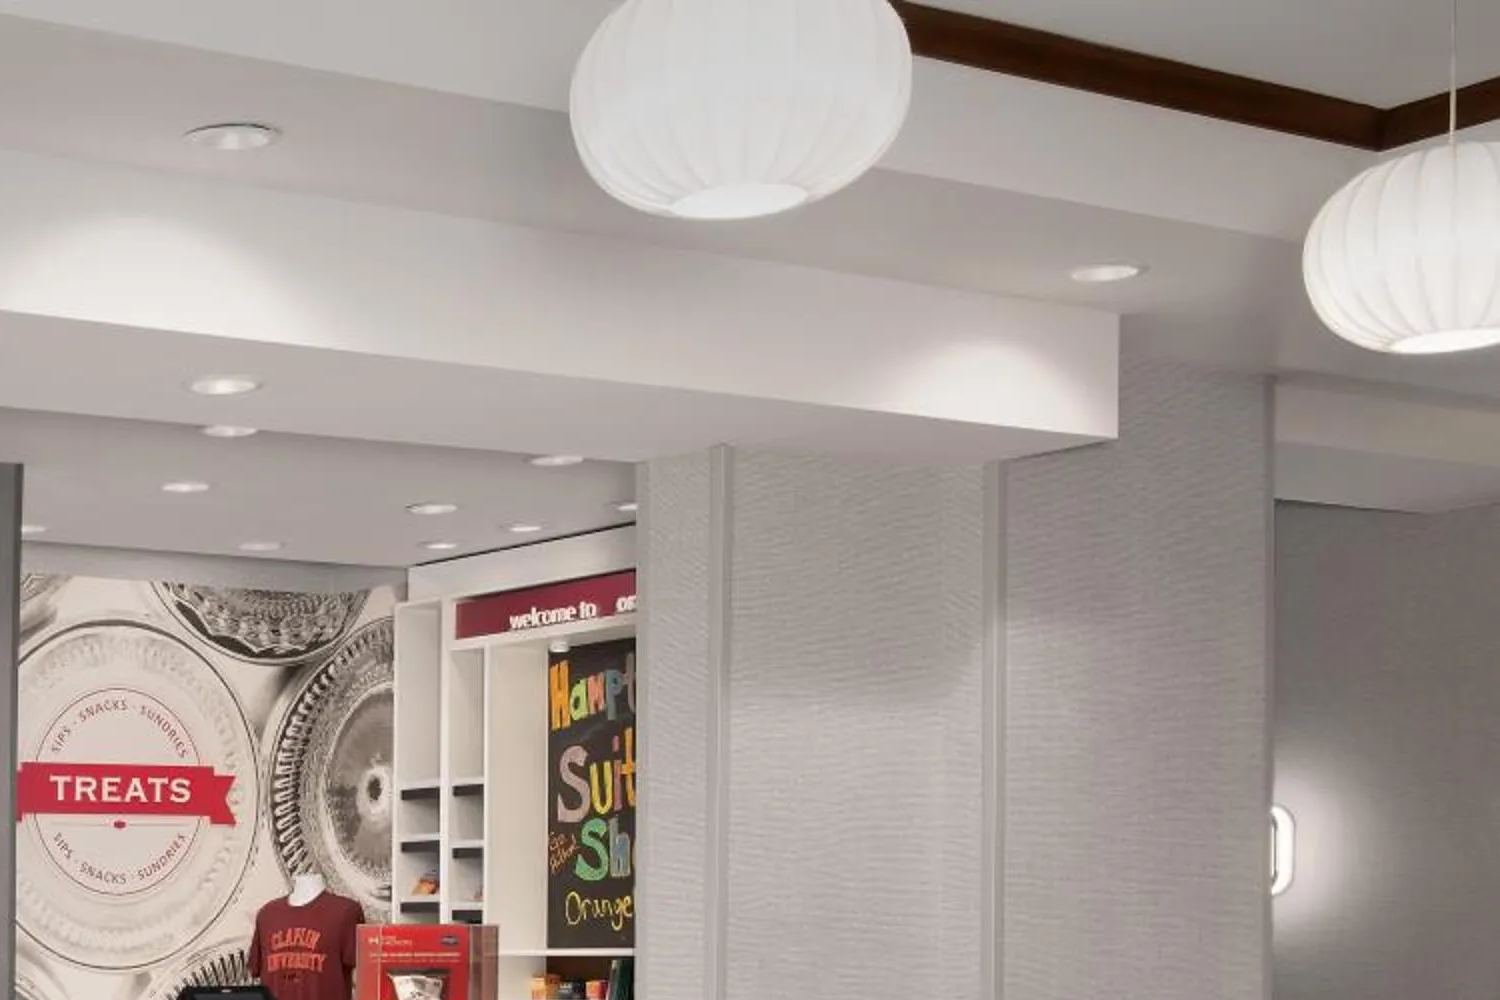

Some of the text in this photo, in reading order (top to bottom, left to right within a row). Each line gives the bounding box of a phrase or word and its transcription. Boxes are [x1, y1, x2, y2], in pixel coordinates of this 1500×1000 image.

[509, 606, 577, 629] welcome
[579, 601, 597, 619] to
[51, 699, 188, 758] SIPS SNACKS SUNDRIES
[49, 774, 192, 803] TREATS
[53, 832, 187, 885] SIPS SNACKS SUNDRIES
[575, 817, 635, 881] Sh
